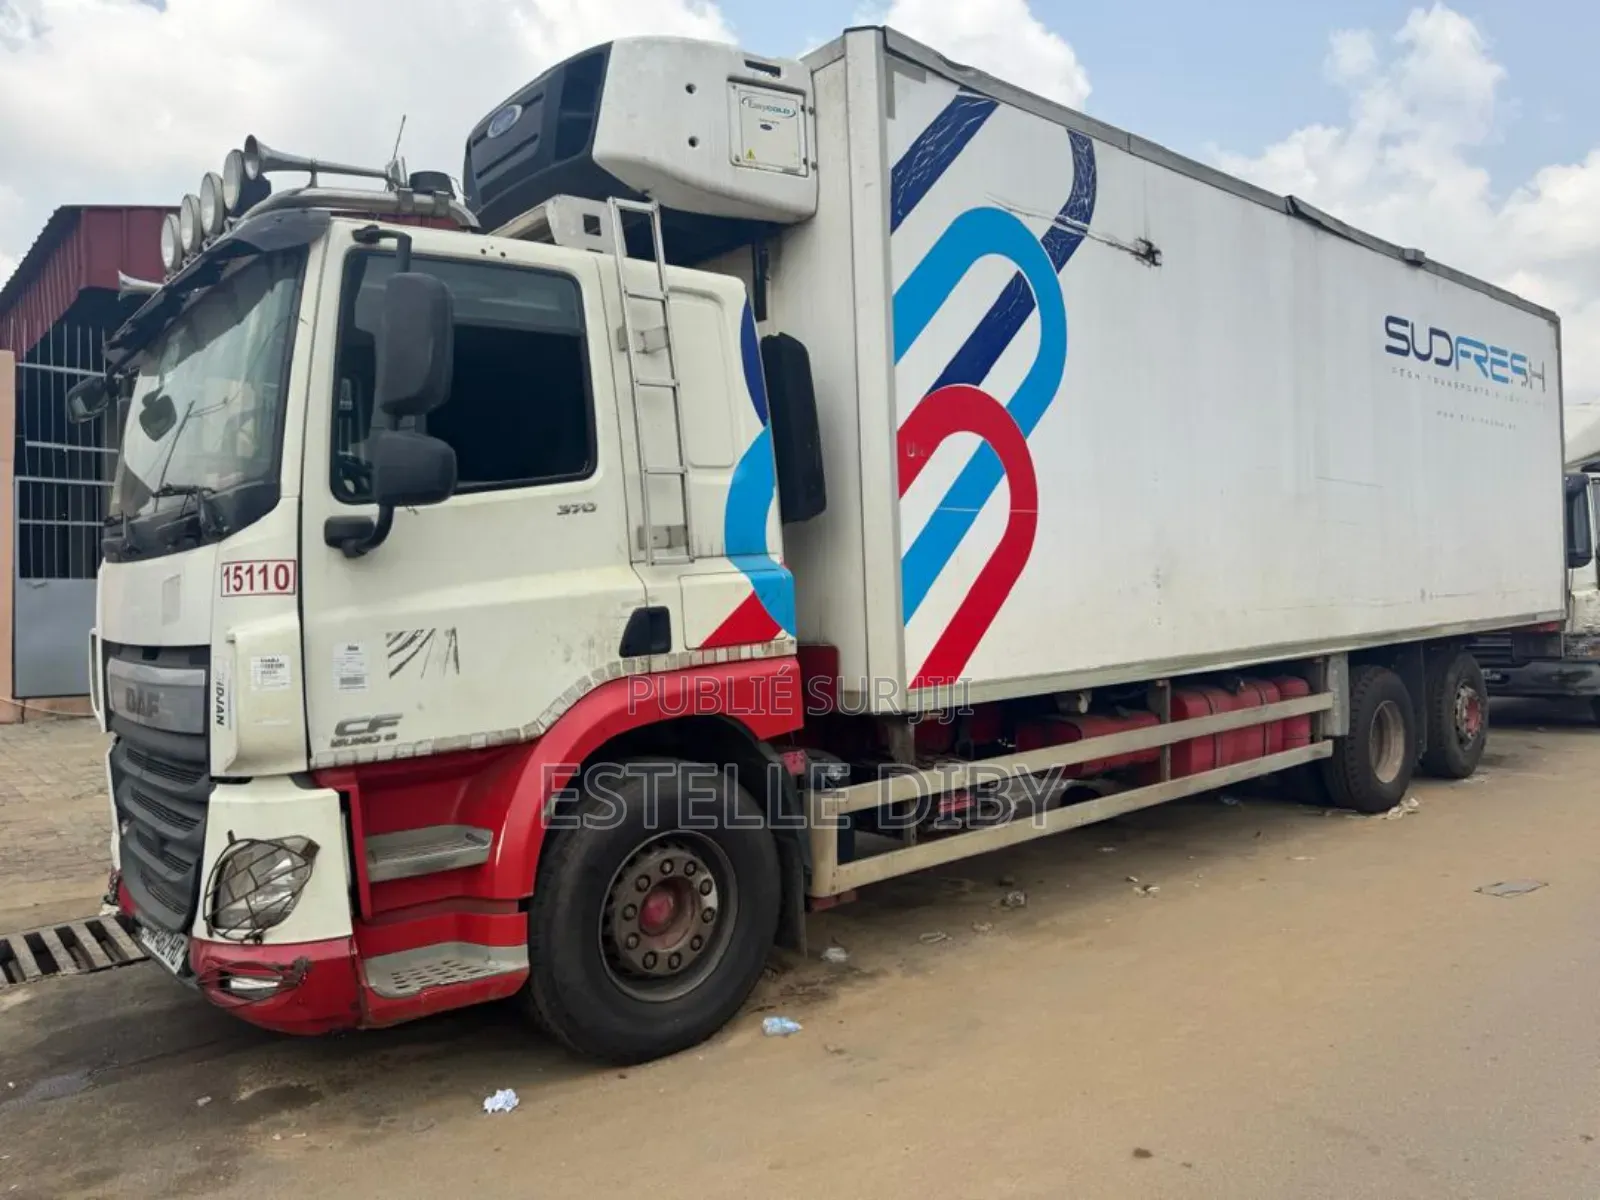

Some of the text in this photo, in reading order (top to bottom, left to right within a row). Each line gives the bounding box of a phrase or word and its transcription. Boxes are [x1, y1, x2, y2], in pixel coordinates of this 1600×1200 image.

[1385, 315, 1547, 393] SUDFRESH
[556, 502, 597, 516] 370
[223, 563, 290, 593] 15110
